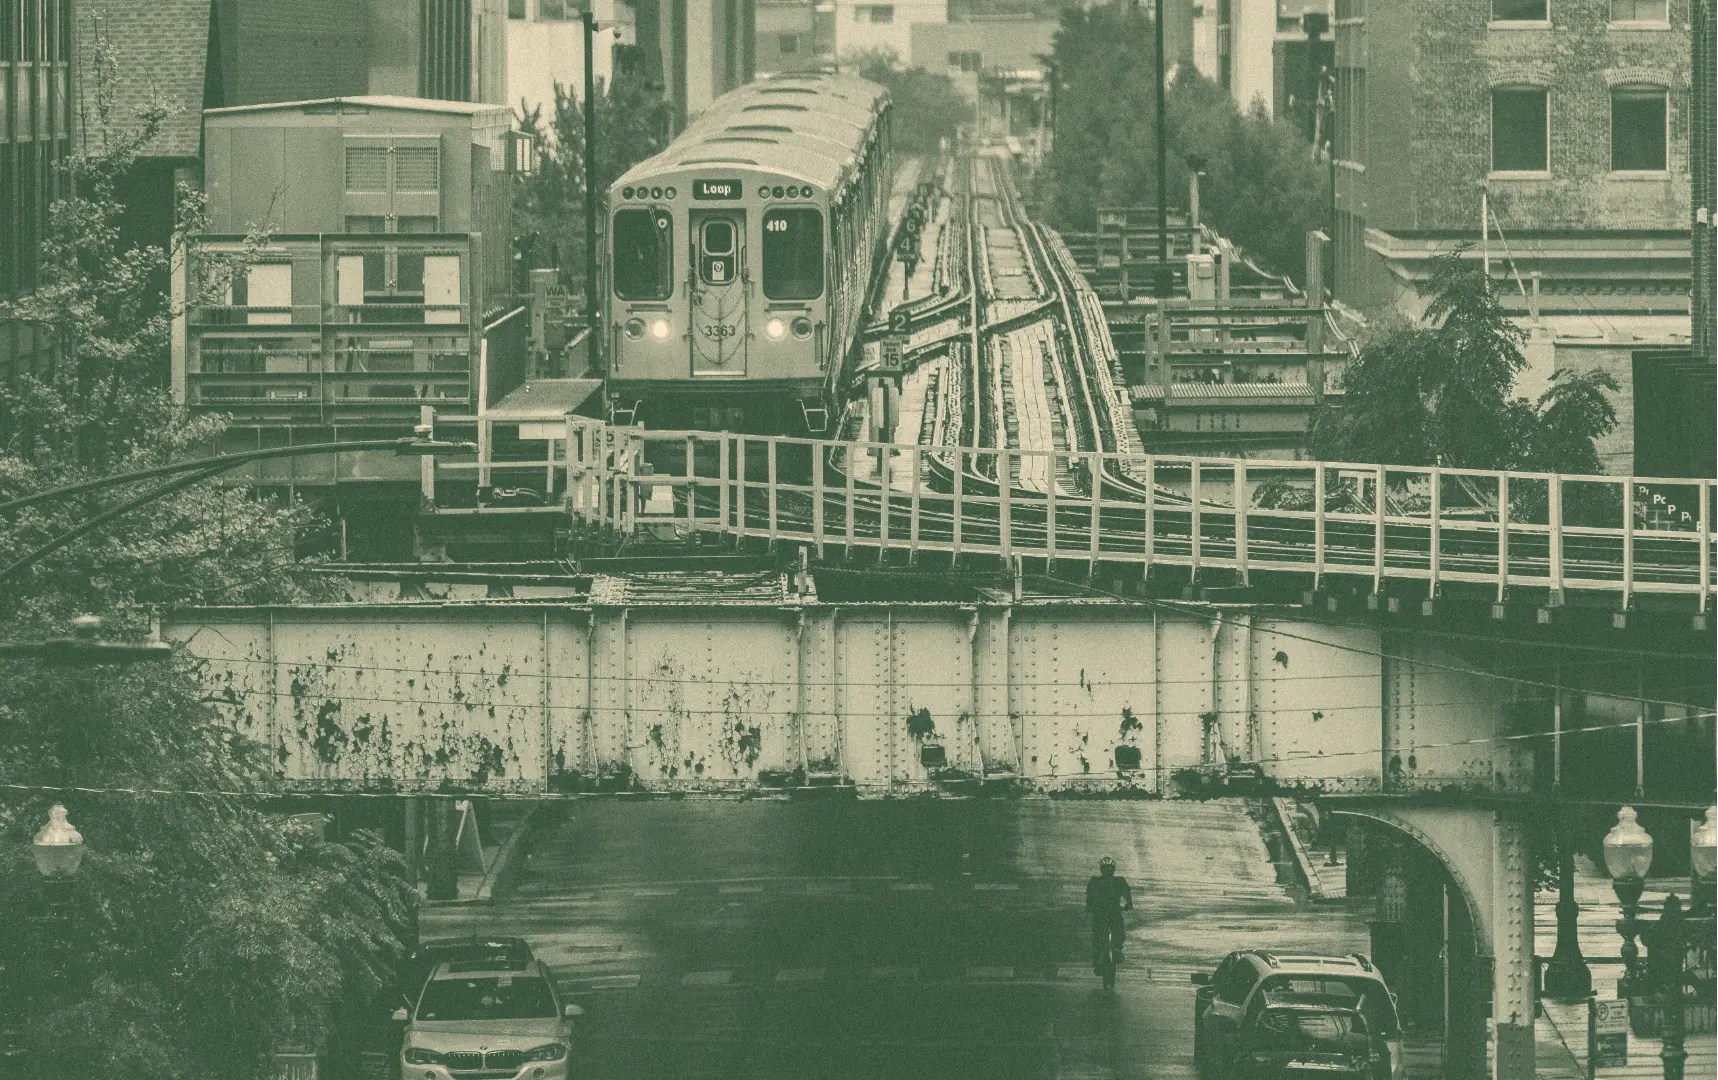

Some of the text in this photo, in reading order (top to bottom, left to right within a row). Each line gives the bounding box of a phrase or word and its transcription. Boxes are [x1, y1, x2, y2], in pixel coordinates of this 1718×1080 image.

[703, 183, 731, 196] Loop
[766, 220, 787, 232] 410
[900, 237, 910, 251] 4
[894, 314, 907, 332] 2
[705, 325, 736, 337] 3363
[883, 353, 900, 367] 15
